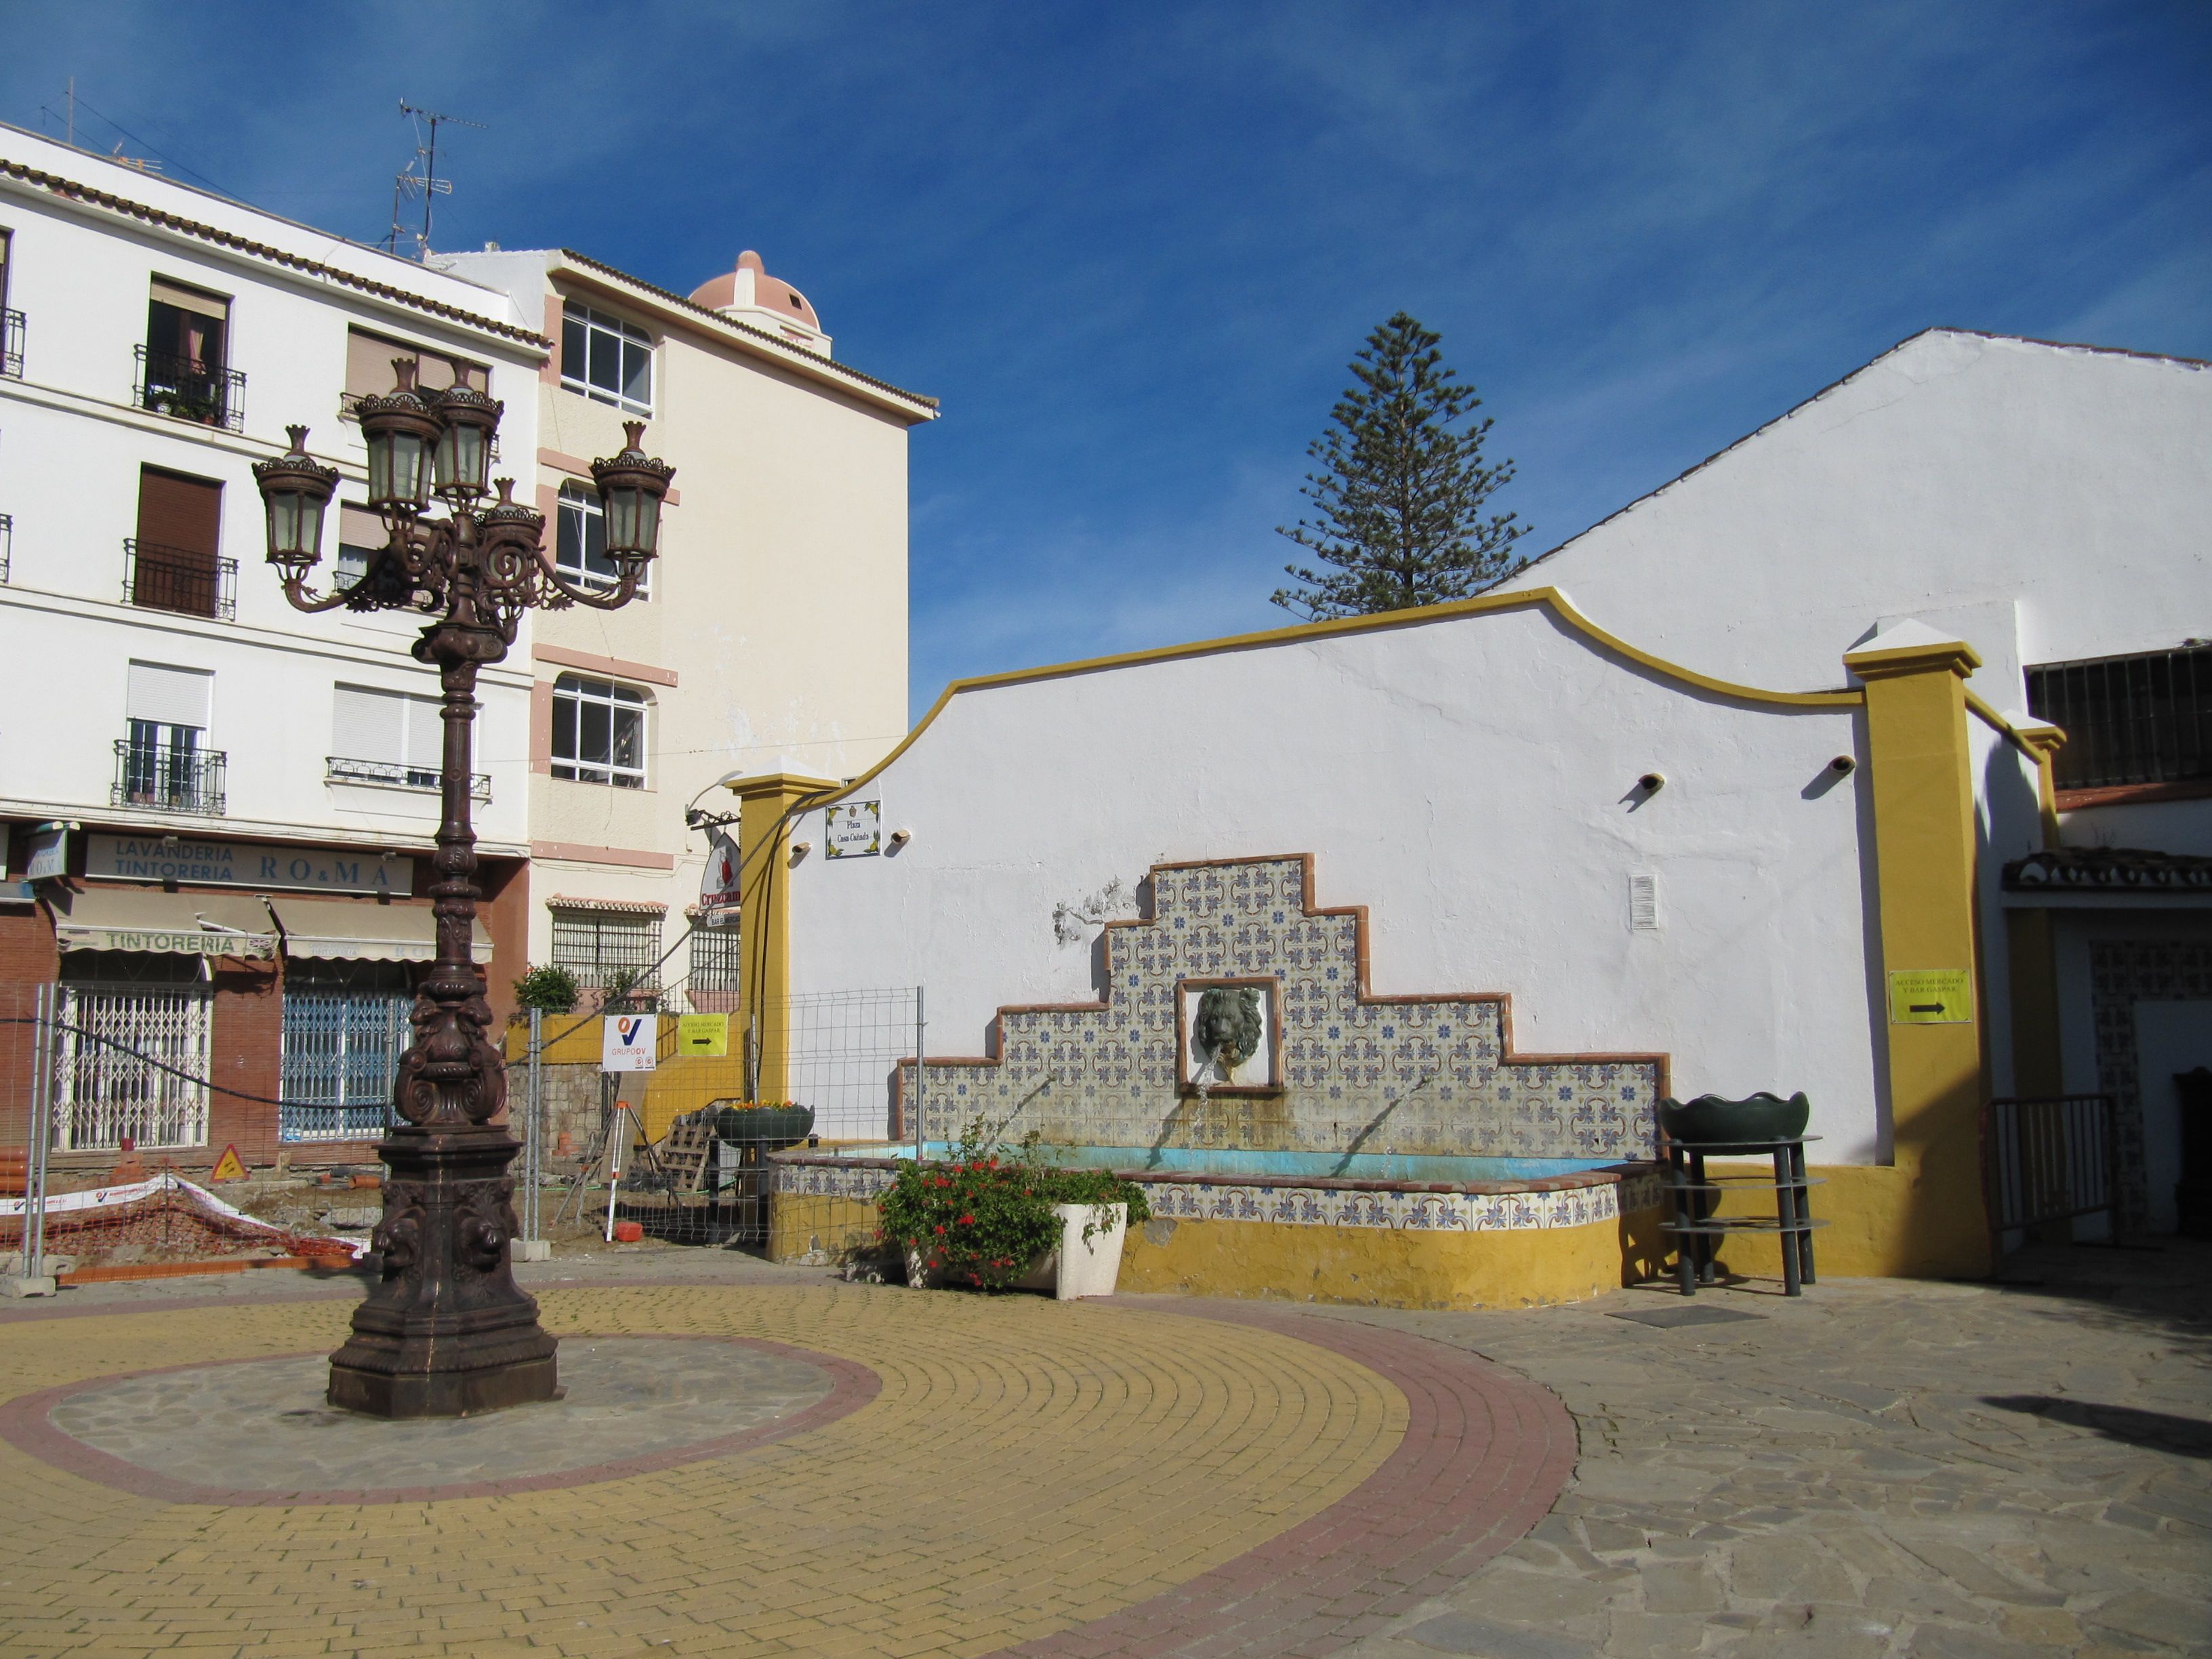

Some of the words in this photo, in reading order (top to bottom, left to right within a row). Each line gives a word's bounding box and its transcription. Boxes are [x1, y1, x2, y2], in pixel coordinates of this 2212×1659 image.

[846, 821, 861, 829] Plaza
[838, 834, 849, 842] Casa
[850, 832, 869, 841] Cañada
[117, 840, 232, 862] LAVANDERIA
[116, 859, 232, 880] TINTORERIA
[106, 931, 234, 952] TINTORERIA
